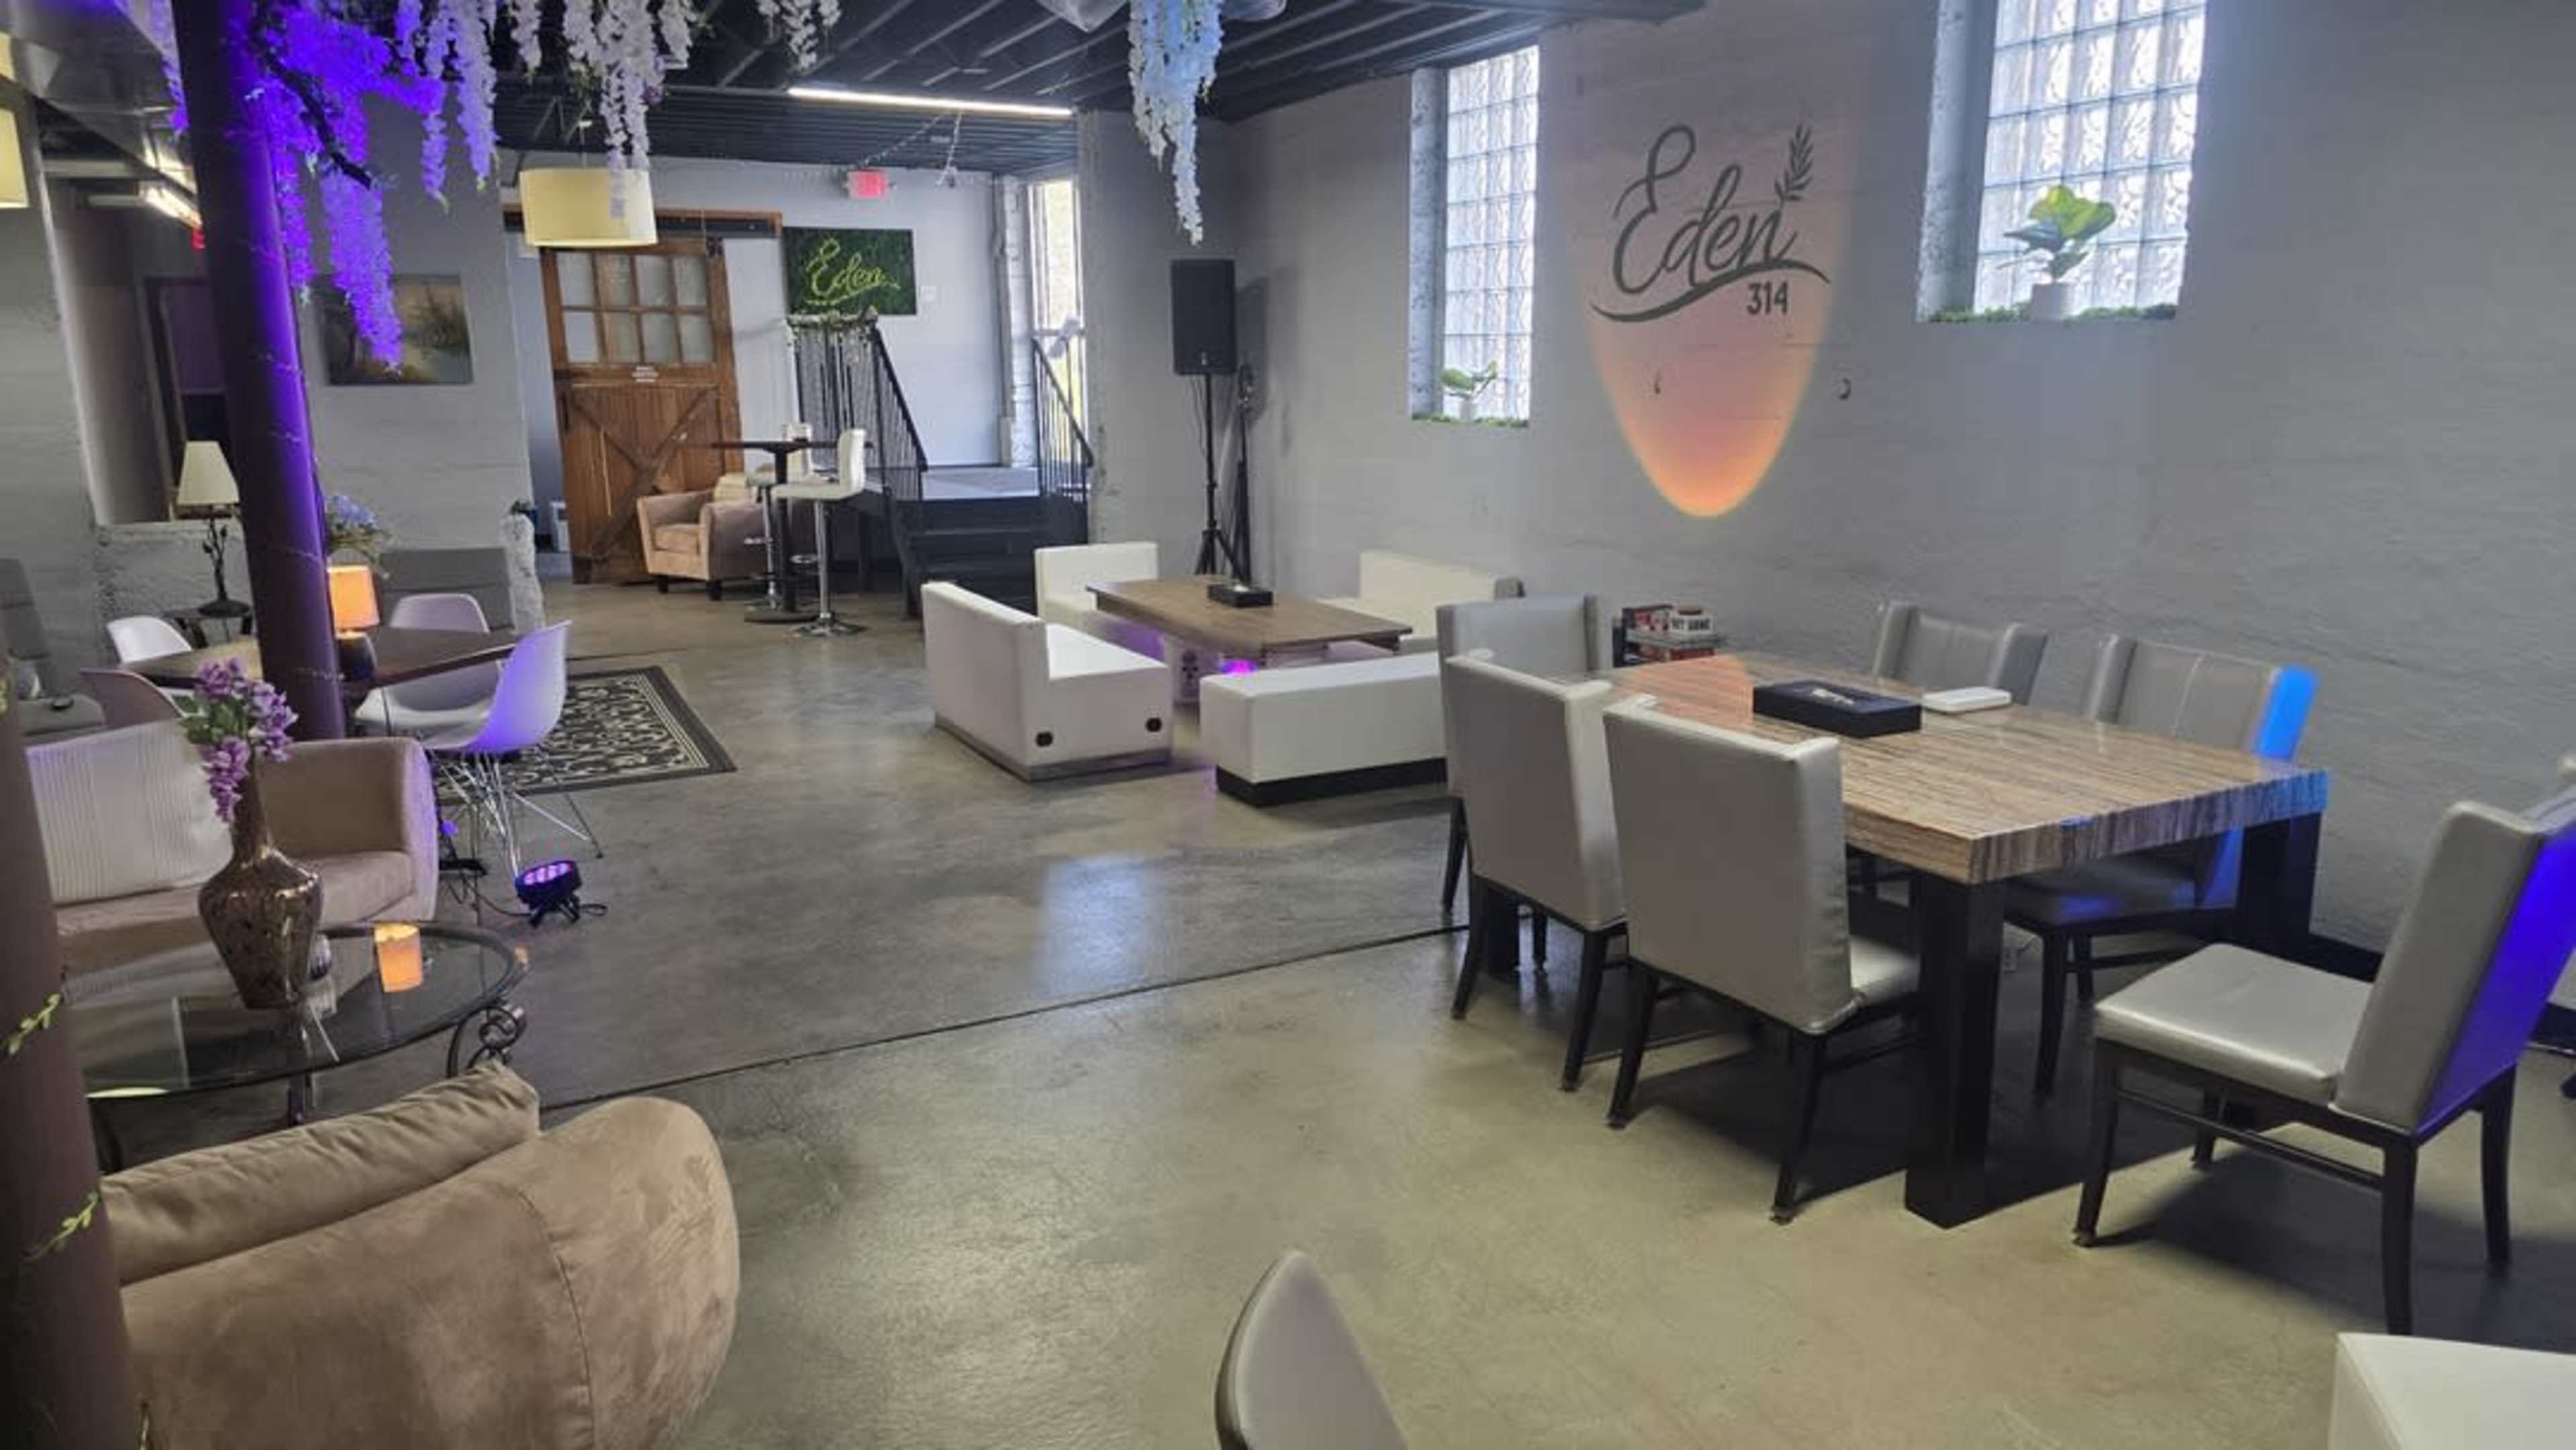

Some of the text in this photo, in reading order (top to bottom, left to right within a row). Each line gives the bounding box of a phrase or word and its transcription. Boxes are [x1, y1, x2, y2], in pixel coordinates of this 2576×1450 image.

[1613, 123, 1799, 295] Eden
[806, 237, 887, 297] Eden
[1746, 281, 1789, 316] 314
